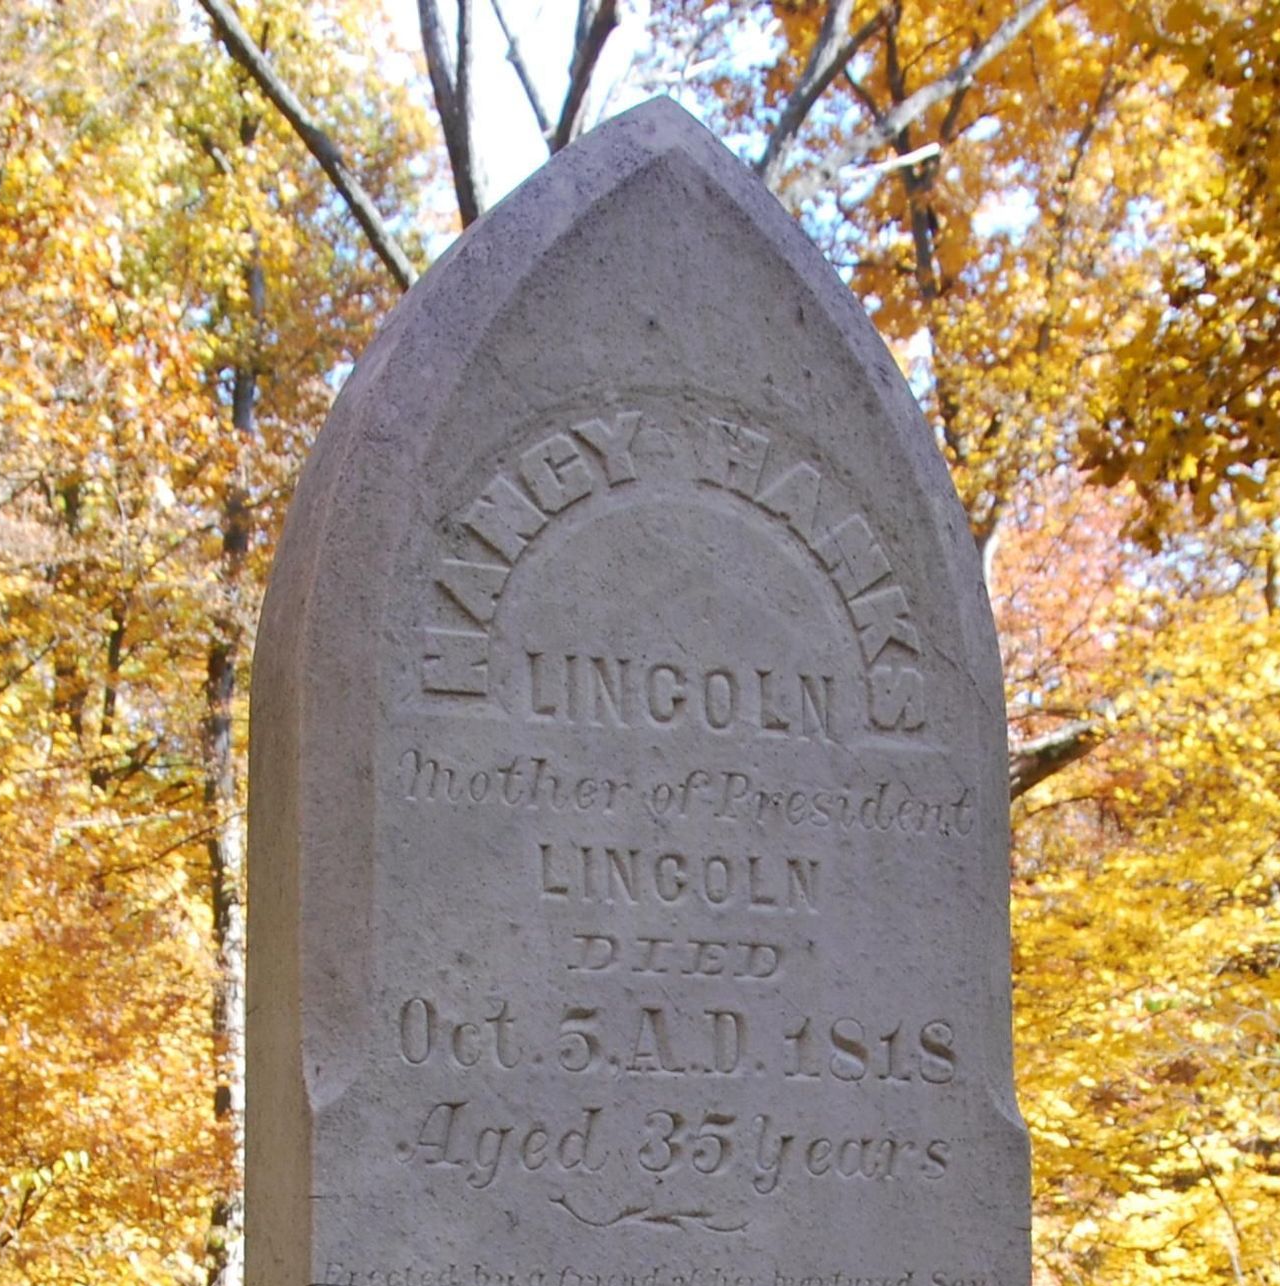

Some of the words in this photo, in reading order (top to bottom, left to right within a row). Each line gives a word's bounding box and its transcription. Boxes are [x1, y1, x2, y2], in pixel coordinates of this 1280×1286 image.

[422, 410, 642, 696] NANCY
[697, 416, 926, 732] HANKS
[525, 650, 836, 746] LINCOLN
[651, 769, 711, 819] of
[713, 770, 976, 838] President
[537, 842, 819, 914] LINCOLN
[566, 933, 786, 980] DIED
[400, 998, 546, 1069] Oct.
[783, 1015, 959, 1085] 1818
[394, 1100, 608, 1190] Aged
[637, 1108, 738, 1175] 35
